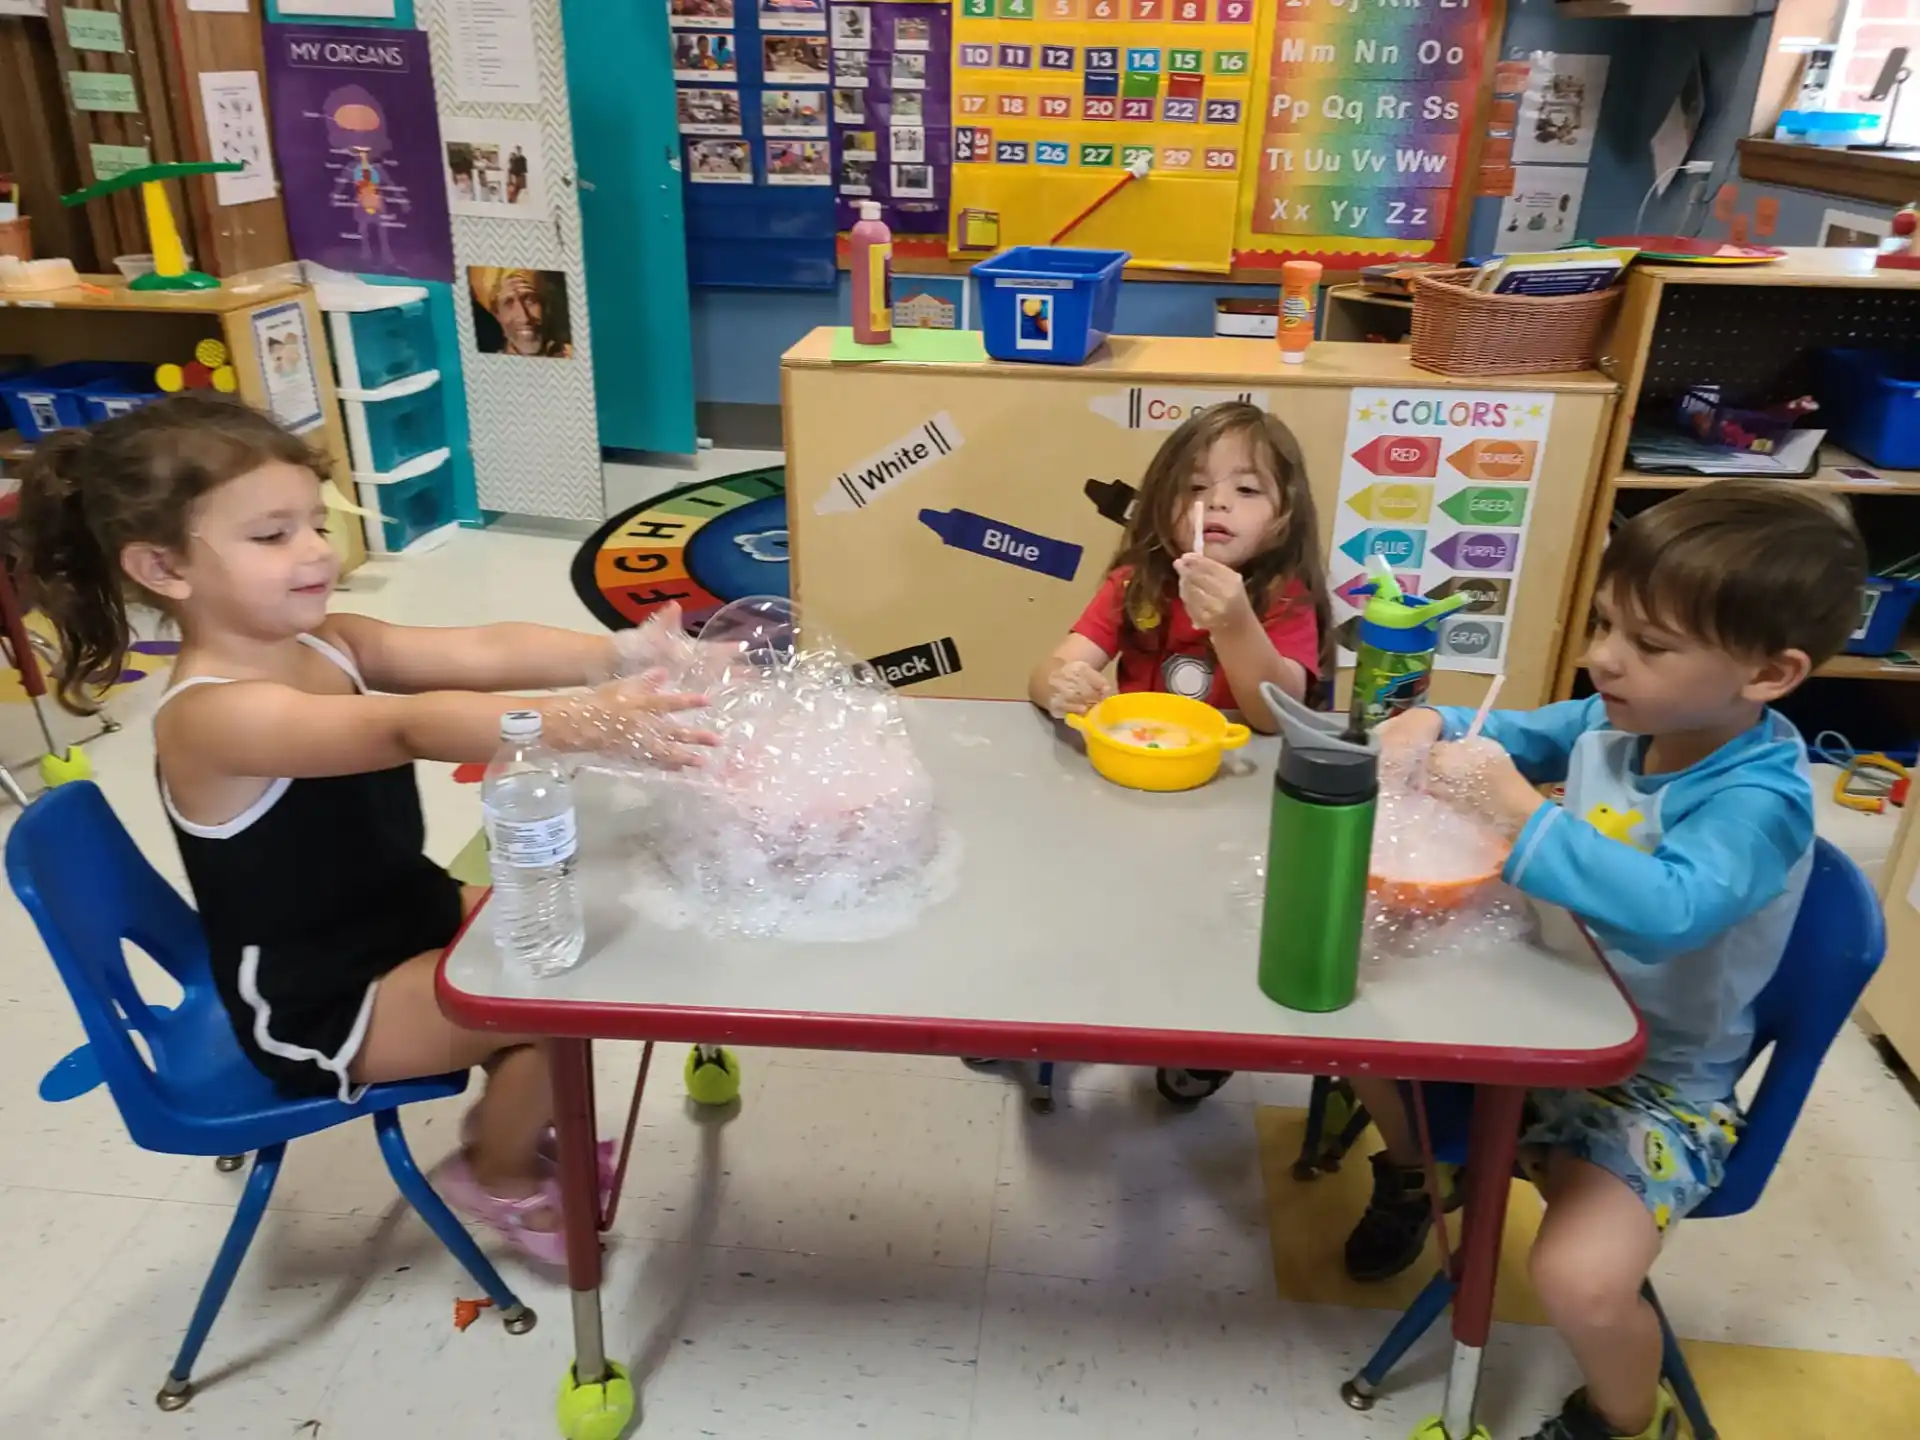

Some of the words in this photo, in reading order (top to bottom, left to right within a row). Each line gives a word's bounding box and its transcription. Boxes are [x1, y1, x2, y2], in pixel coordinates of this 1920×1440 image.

[971, 0, 986, 14] 3
[1009, 0, 1025, 13] 4
[1053, 0, 1069, 15] 5
[1095, 1, 1111, 17] 6
[1140, 1, 1156, 17] 7
[1182, 2, 1197, 19] 8
[1227, 2, 1243, 19] 9
[290, 42, 321, 60] MY
[324, 43, 404, 66] ORGANS
[965, 48, 989, 64] 10
[1005, 48, 1025, 65] 11
[1047, 49, 1069, 66] 12
[1090, 51, 1113, 67] 13
[1132, 53, 1155, 68] 14
[1174, 53, 1197, 69] 15
[1220, 55, 1243, 70] 16
[962, 97, 985, 112] 17
[1001, 98, 1024, 113] 18
[1044, 99, 1067, 114] 19
[1086, 101, 1113, 116] 20
[1125, 102, 1148, 117] 21
[1166, 101, 1194, 117] 22
[1208, 104, 1236, 119] 23
[1272, 94, 1310, 123] Pp
[1321, 95, 1363, 125] Qq
[1376, 96, 1413, 120] Rr
[1422, 96, 1460, 120] Ss
[957, 130, 972, 158] 24
[975, 132, 989, 155] 31
[999, 145, 1025, 160] 25
[1038, 146, 1065, 161] 26
[1083, 148, 1112, 162] 27
[1164, 149, 1192, 165] 29
[1206, 151, 1235, 167] 30
[1266, 148, 1294, 172] Tt
[1304, 149, 1340, 172] Uu
[1352, 149, 1386, 173] Vv
[1396, 149, 1447, 174] Ww
[1392, 400, 1508, 427] COLORS
[858, 443, 929, 490] White
[1390, 448, 1421, 463] RED
[1469, 499, 1514, 513] GREEN
[626, 521, 687, 539] H
[983, 529, 1040, 561] Blue
[1374, 541, 1410, 556] BLUE
[1459, 546, 1509, 559] PURPLE
[613, 553, 669, 574] G
[626, 588, 691, 605] F
[1449, 631, 1488, 645] GRAY
